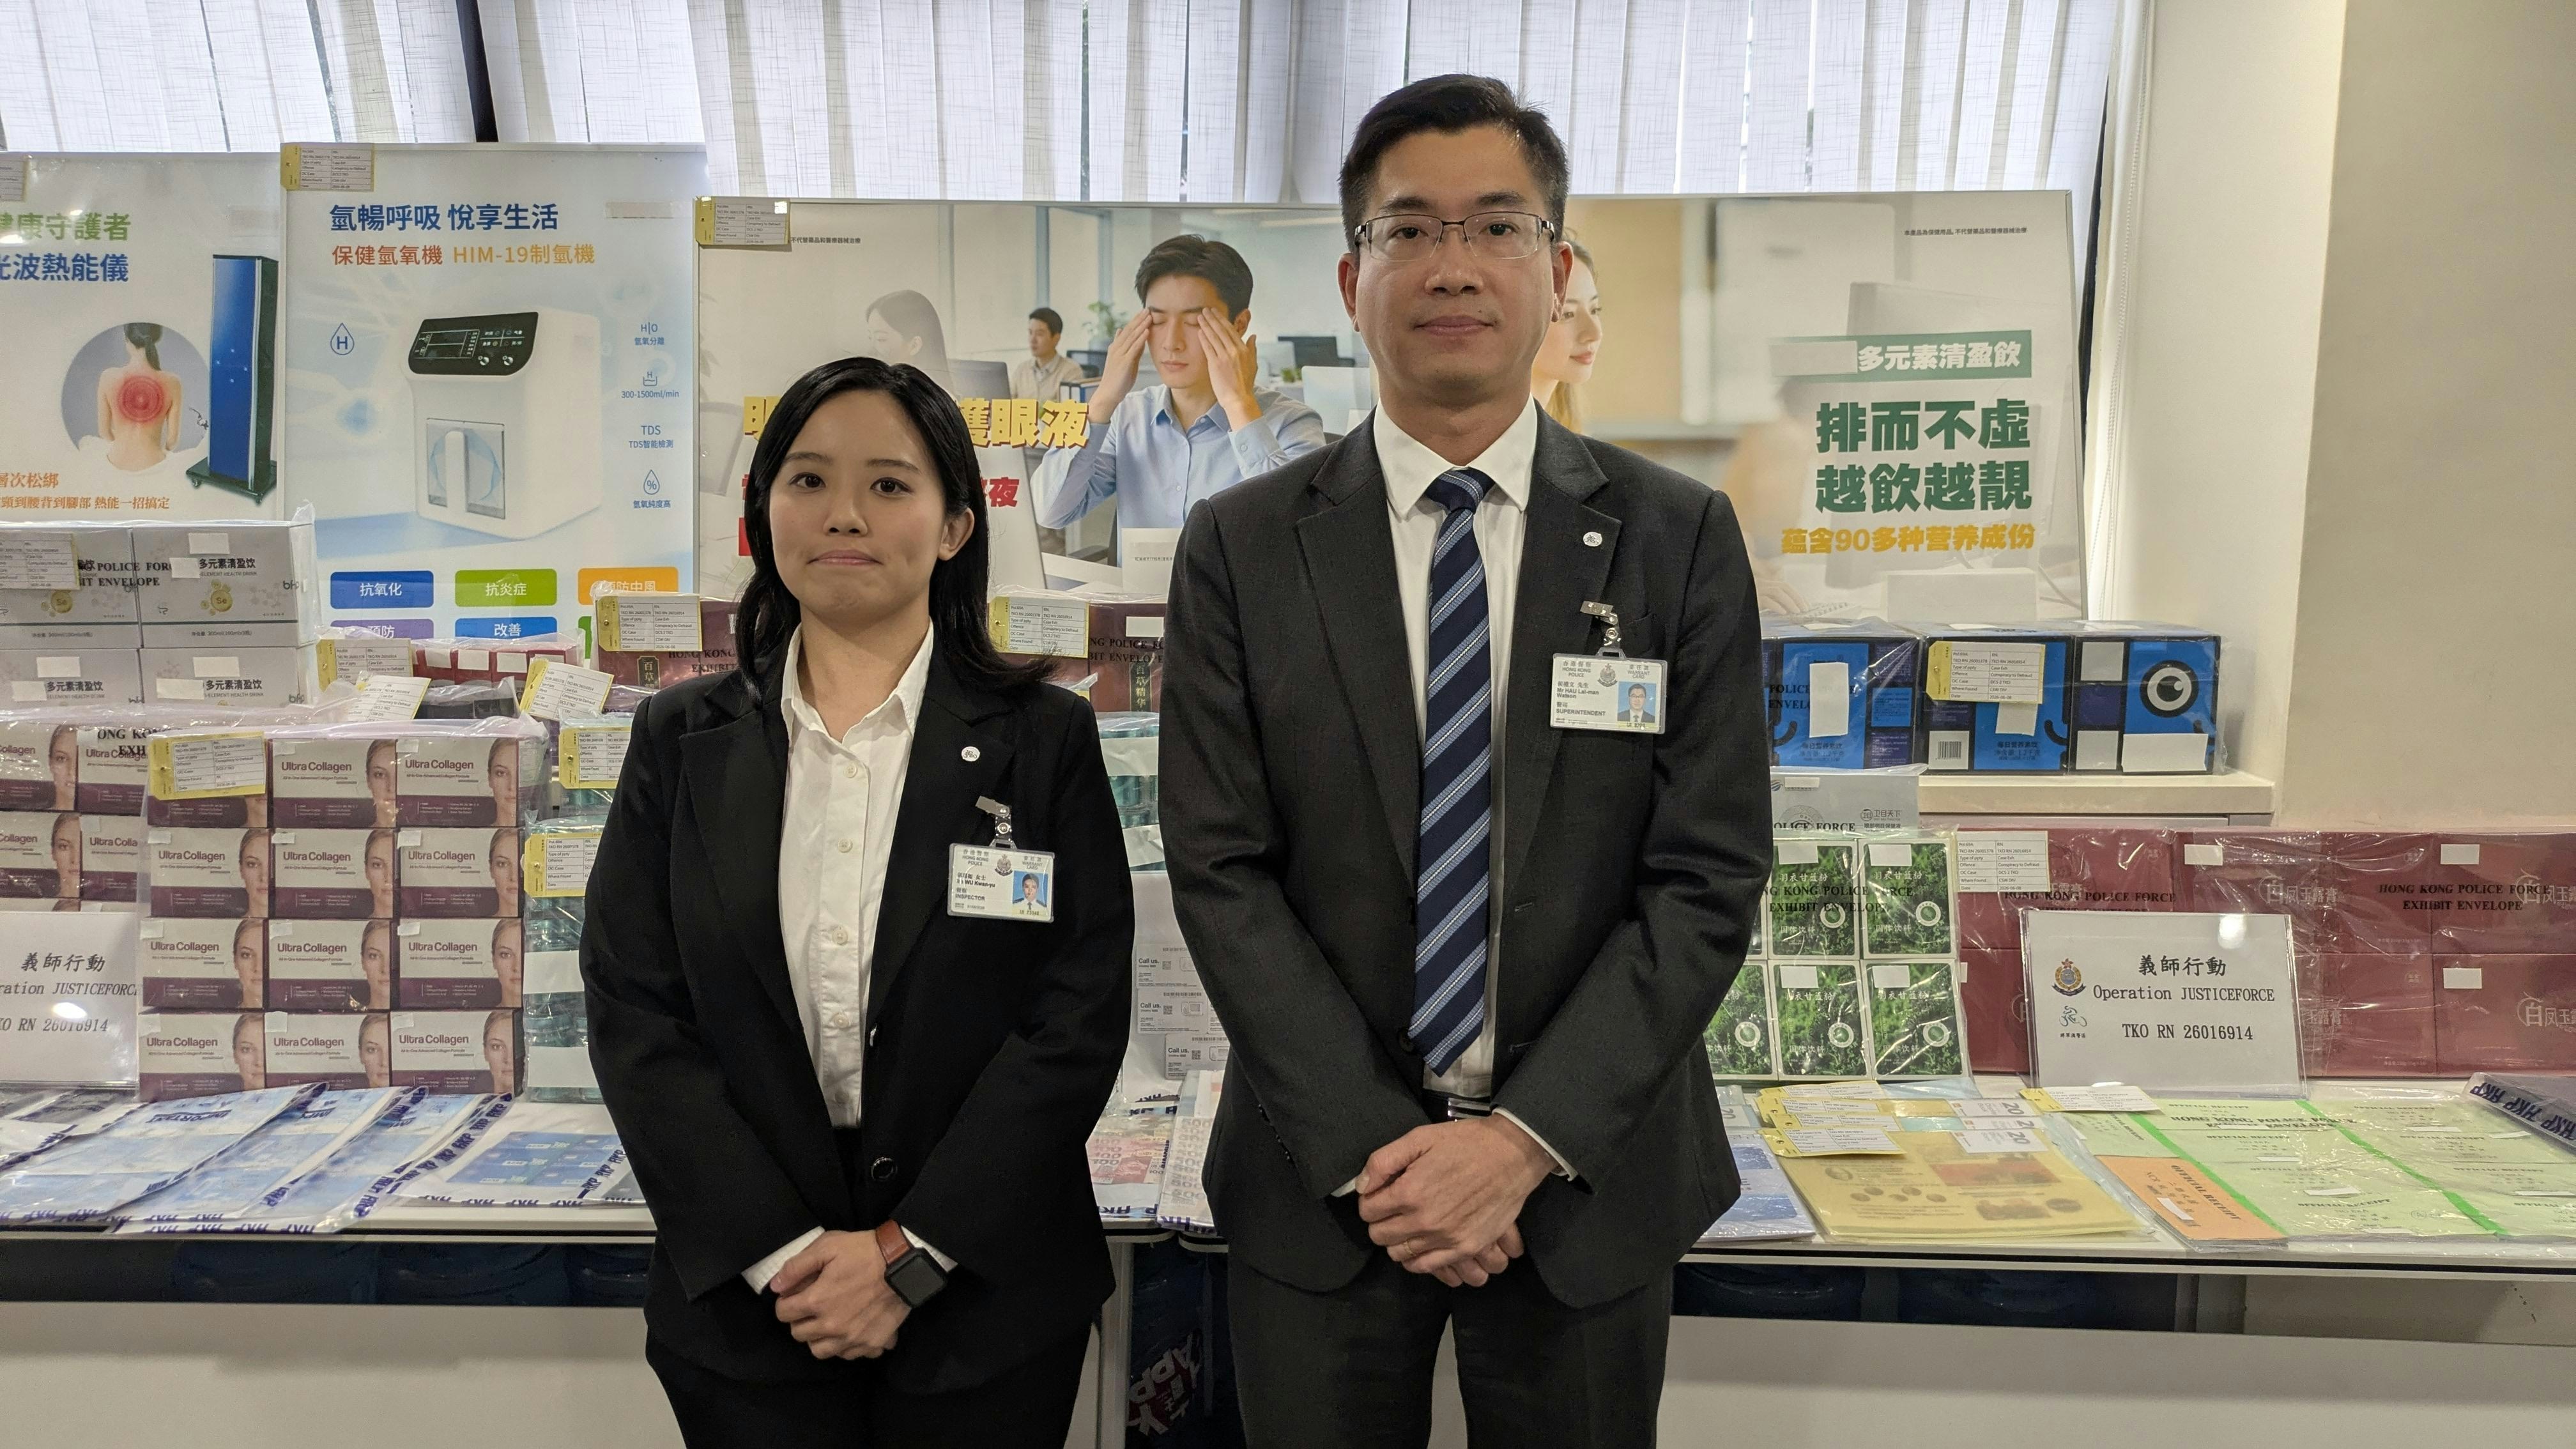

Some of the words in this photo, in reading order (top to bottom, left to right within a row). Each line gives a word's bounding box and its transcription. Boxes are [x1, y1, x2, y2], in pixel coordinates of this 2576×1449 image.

[330, 204, 441, 231] 氫暢呼吸
[448, 204, 558, 231] 悅享生活
[332, 245, 443, 266] 保健氫氧機
[453, 244, 595, 265] HIM-19制氫機
[1859, 341, 2020, 372] 多元素清盈飲
[621, 390, 679, 399] 300-1500ml/min
[641, 425, 661, 435] TDS
[1816, 461, 2032, 514] 越飲越靚
[98, 562, 141, 572] POLICE
[199, 558, 256, 569] 多元素清盈饮
[99, 577, 160, 586] ENVELOPE
[360, 583, 402, 597] 抗氧化
[485, 582, 527, 596] 抗炎症
[494, 624, 521, 637] 改善
[206, 679, 263, 691] 多元素清盈饮
[281, 762, 307, 771] Ultra
[308, 762, 352, 773] Collagen
[405, 760, 429, 769] Ultra
[431, 760, 474, 772] Collagen
[1816, 823, 1855, 831] FORCE
[90, 837, 113, 847] Ultra
[114, 838, 138, 847] Colla
[158, 850, 182, 860] Ultra
[184, 850, 226, 862] Collagen
[284, 852, 307, 861] Ultra
[309, 851, 351, 864] Collagen
[408, 851, 432, 860] Ultra
[433, 851, 475, 862] Collagen
[1784, 886, 1818, 896] KONG
[1824, 886, 1869, 896] POLICE
[2380, 884, 2415, 894] HONG
[2420, 884, 2453, 894] KONG
[2458, 884, 2503, 894] POLICE
[2510, 884, 2549, 895] FORCE
[2085, 892, 2129, 902] POLICE
[2135, 893, 2176, 902] FORCE
[1770, 902, 1818, 912] EXHIBIT
[2403, 901, 2453, 910] EXHIBIT
[2458, 901, 2522, 911] ENVELOPE
[151, 942, 175, 951] Ultra
[176, 942, 220, 953] Collagen
[277, 943, 302, 953] Ultra
[303, 942, 348, 954] Collagen
[409, 942, 433, 952] Ultra
[434, 942, 478, 954] Collagen
[21, 952, 106, 972] 義師行動
[2138, 954, 2227, 977] 義師行動
[0, 981, 44, 995] ration
[2092, 985, 2172, 1000] Operation
[2181, 987, 2275, 1002] JUSTICEFORCE
[19, 1018, 36, 1032] RN
[2122, 1023, 2149, 1038] TKO
[2158, 1025, 2175, 1039] RN
[2183, 1025, 2253, 1040] 26016914
[147, 1038, 172, 1046] Ultra
[173, 1038, 218, 1050] Collagen
[273, 1038, 299, 1046] Ultra
[300, 1038, 345, 1050] Collagen
[399, 1035, 424, 1044] Ultra
[425, 1034, 470, 1047] Collagen
